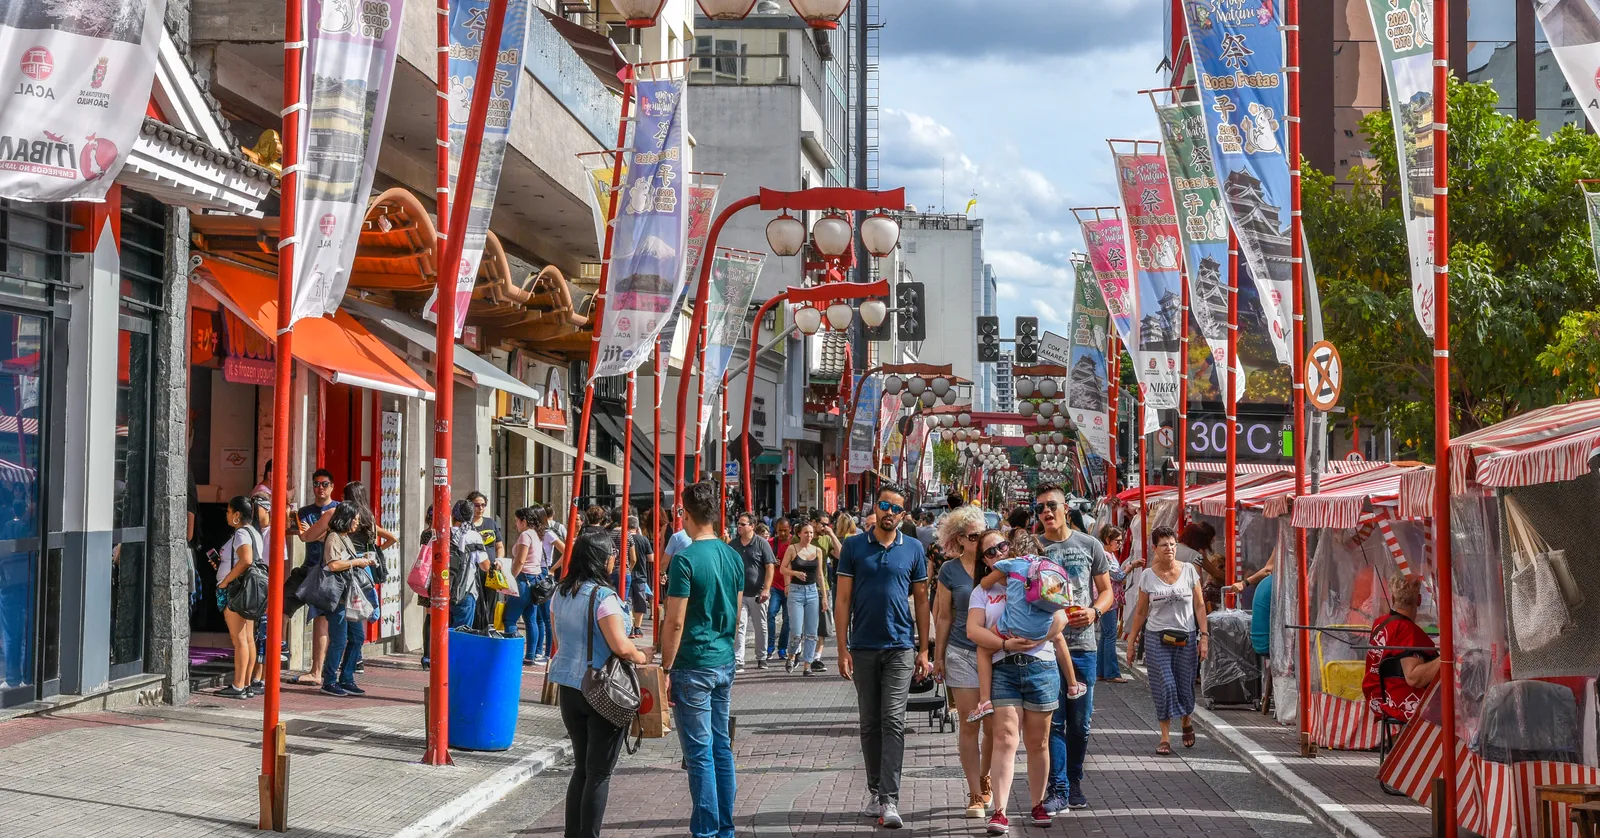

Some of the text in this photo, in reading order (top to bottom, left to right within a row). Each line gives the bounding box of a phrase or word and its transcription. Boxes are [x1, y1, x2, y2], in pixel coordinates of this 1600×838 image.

[1388, 11, 1408, 27] 2020
[1394, 35, 1412, 49] RTO
[1219, 33, 1254, 69] 祭
[1203, 73, 1235, 89] Boas
[1047, 344, 1061, 353] COM
[1150, 383, 1178, 392] NIKKEY
[1190, 421, 1272, 453] 30°C
